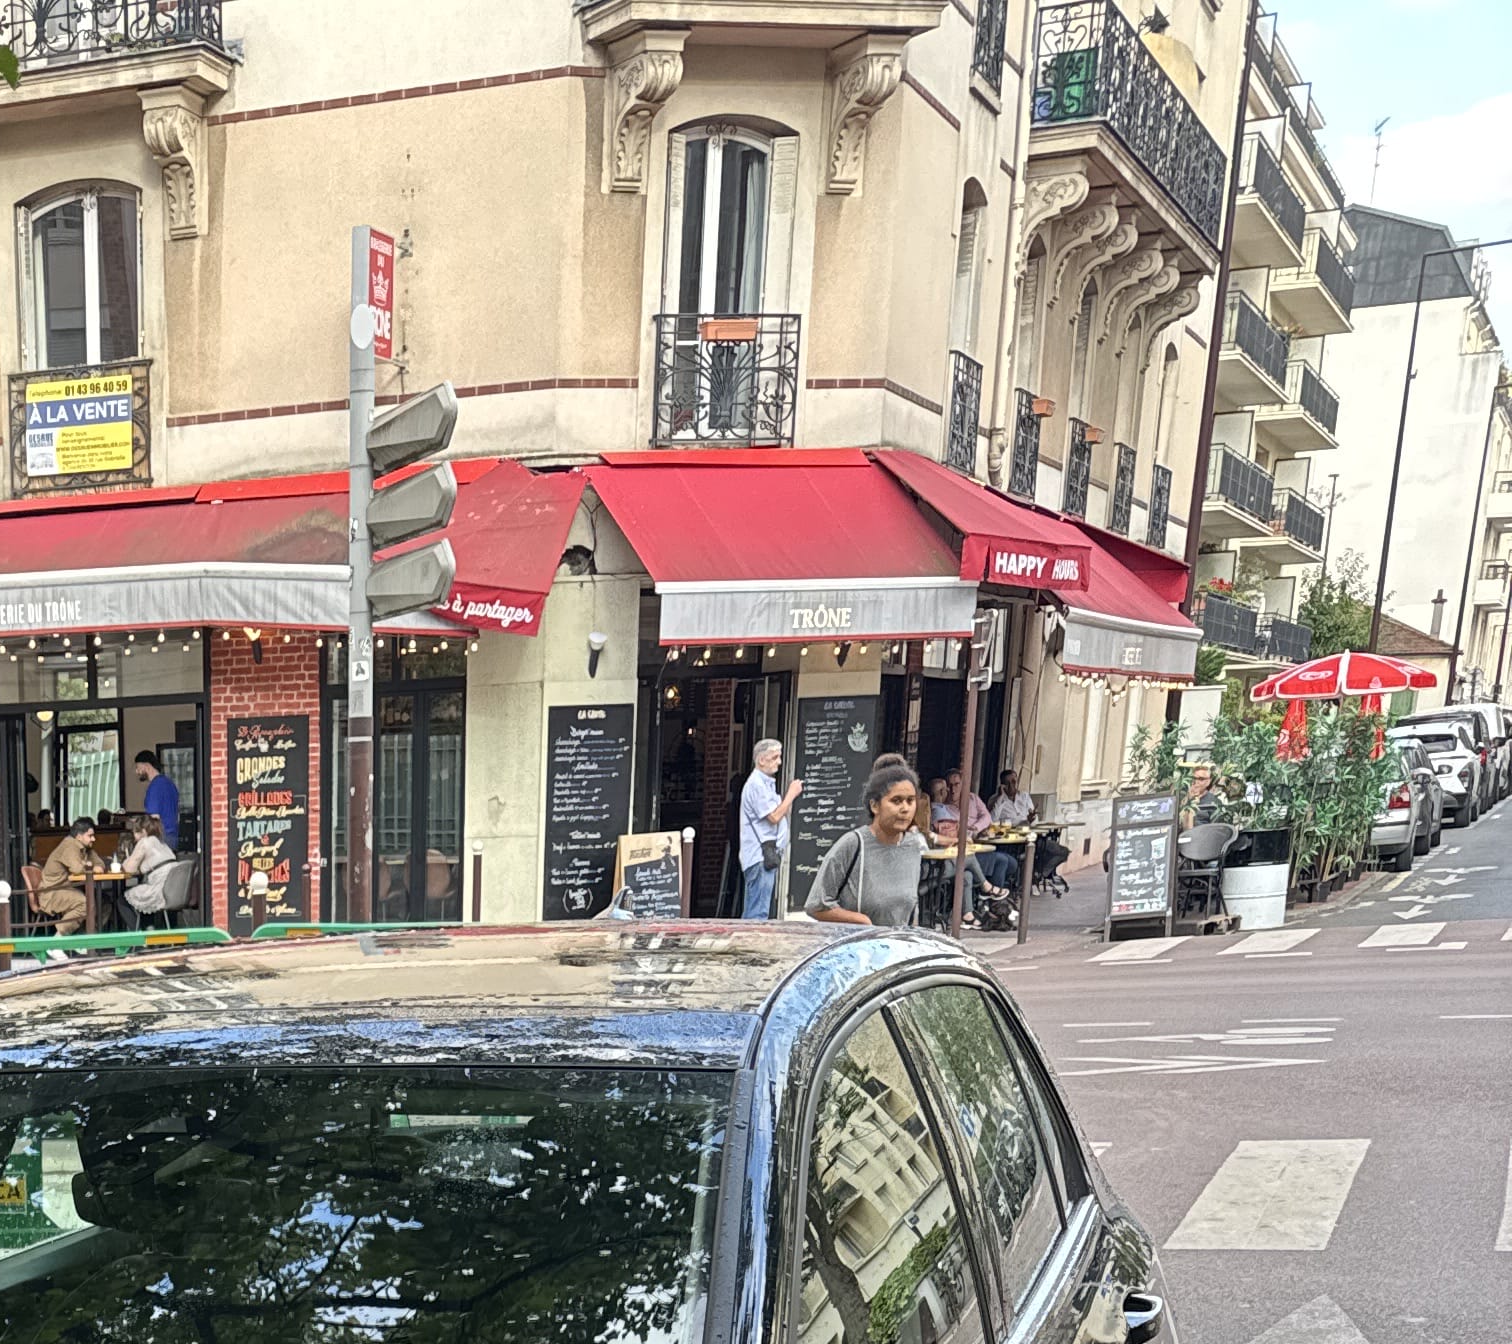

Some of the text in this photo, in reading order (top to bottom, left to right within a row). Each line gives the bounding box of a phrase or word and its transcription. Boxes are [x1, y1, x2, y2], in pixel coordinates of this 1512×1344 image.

[64, 385, 75, 397] 01
[77, 384, 88, 395] 43
[90, 382, 101, 394] 96
[103, 381, 114, 393] 40
[116, 379, 128, 392] 59
[29, 399, 129, 425] À LA VENTE
[994, 551, 1080, 581] HAPPY HOURS
[28, 602, 42, 624] DU
[45, 597, 82, 622] TRÔNE
[452, 593, 465, 613] à
[463, 599, 534, 628] partager
[789, 603, 852, 629] TRÔNE
[236, 755, 286, 785] GRANDES
